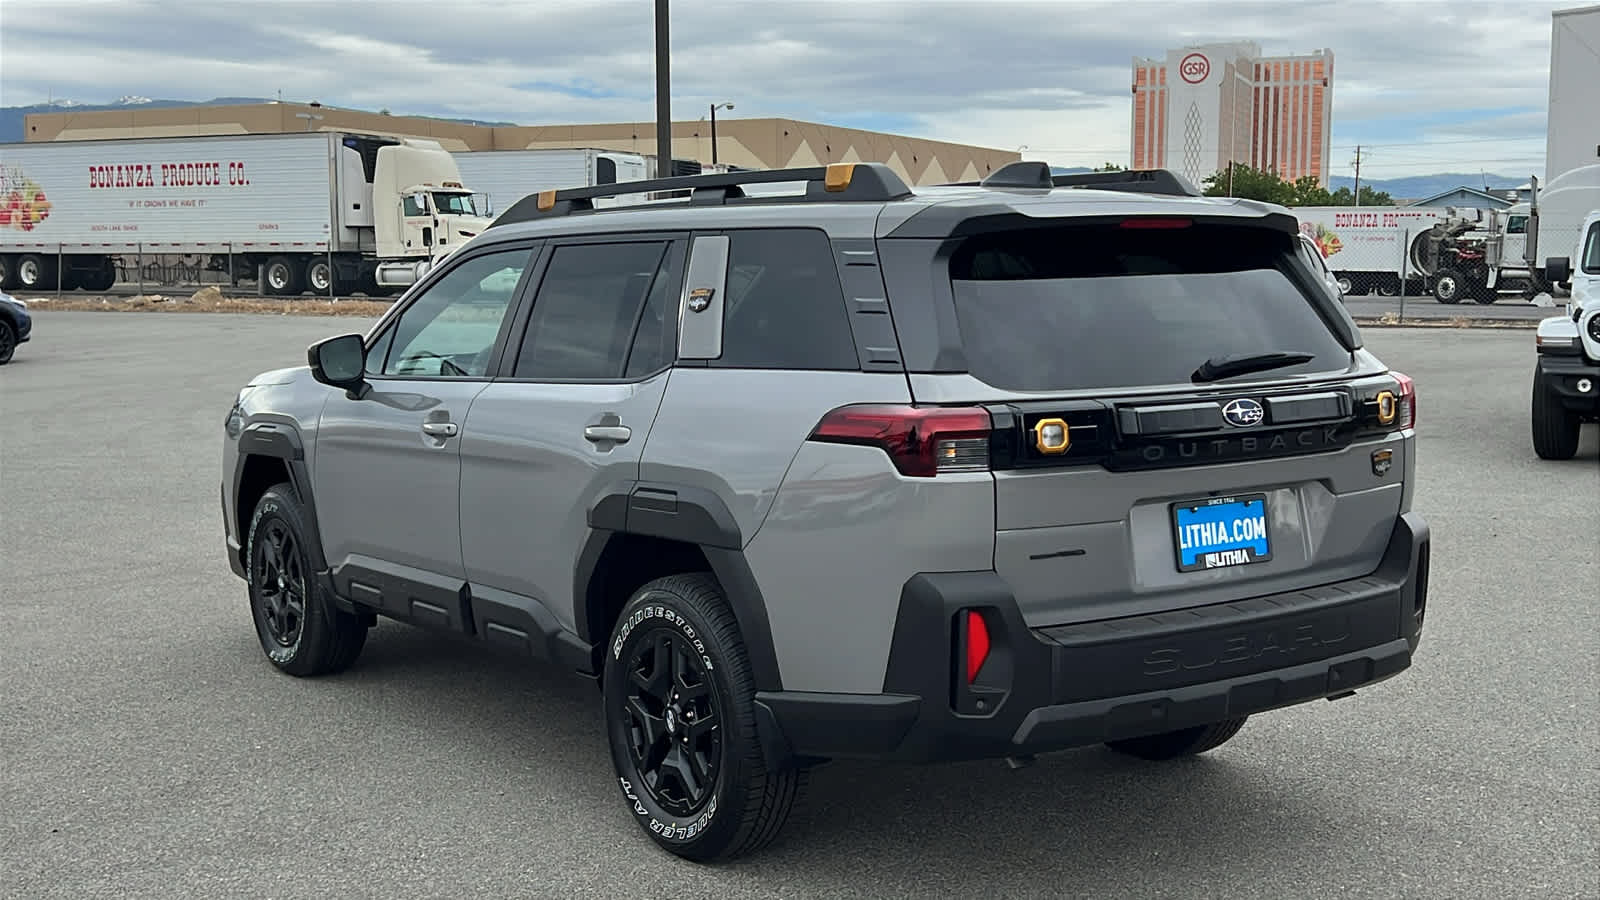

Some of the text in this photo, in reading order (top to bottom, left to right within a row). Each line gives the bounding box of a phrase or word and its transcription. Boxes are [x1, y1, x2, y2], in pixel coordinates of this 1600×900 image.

[1183, 62, 1206, 75] GSR
[89, 162, 250, 188] BONANZA PRODUCE CO.
[1335, 213, 1378, 228] BONANZA
[1143, 428, 1338, 461] OUTBACK
[1178, 516, 1267, 550] LITHIA.COM
[1215, 548, 1250, 567] LITHIA
[613, 606, 714, 670] BRIDGESTONE
[1142, 618, 1351, 677] SUBARU
[620, 776, 717, 840] DUELER A/T
